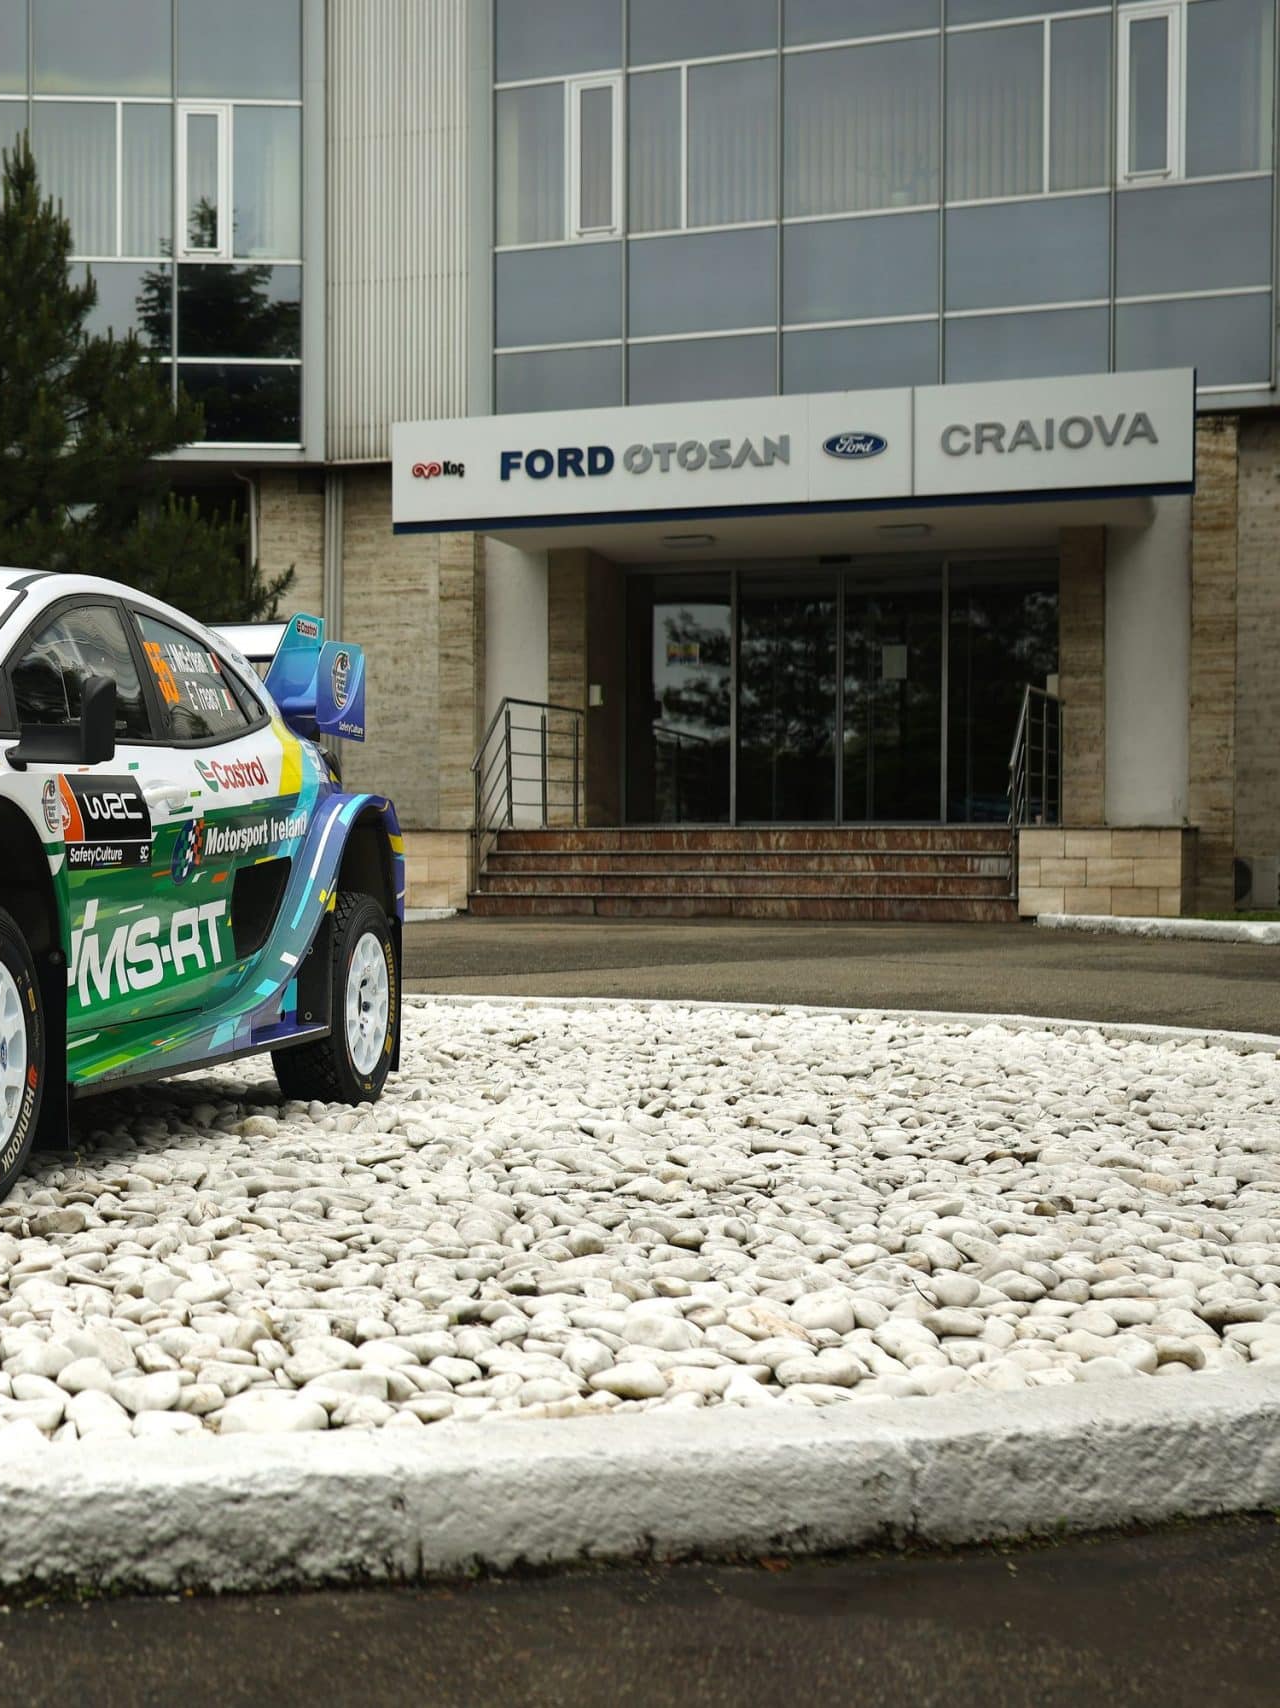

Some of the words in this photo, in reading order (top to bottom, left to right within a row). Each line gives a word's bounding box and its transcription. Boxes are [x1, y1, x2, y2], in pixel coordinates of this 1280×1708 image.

[834, 434, 876, 455] Ford
[940, 412, 1159, 457] CRAIOVA
[442, 460, 465, 478] Koç
[500, 445, 615, 481] FORD
[623, 434, 790, 475] OTOSAN
[210, 755, 270, 790] Castrol
[82, 792, 144, 820] WRC
[205, 818, 269, 856] Motorsport
[270, 810, 309, 843] Ireland
[69, 845, 124, 868] SafetyCulture
[139, 845, 150, 860] SC
[78, 898, 227, 1008] MS-RT
